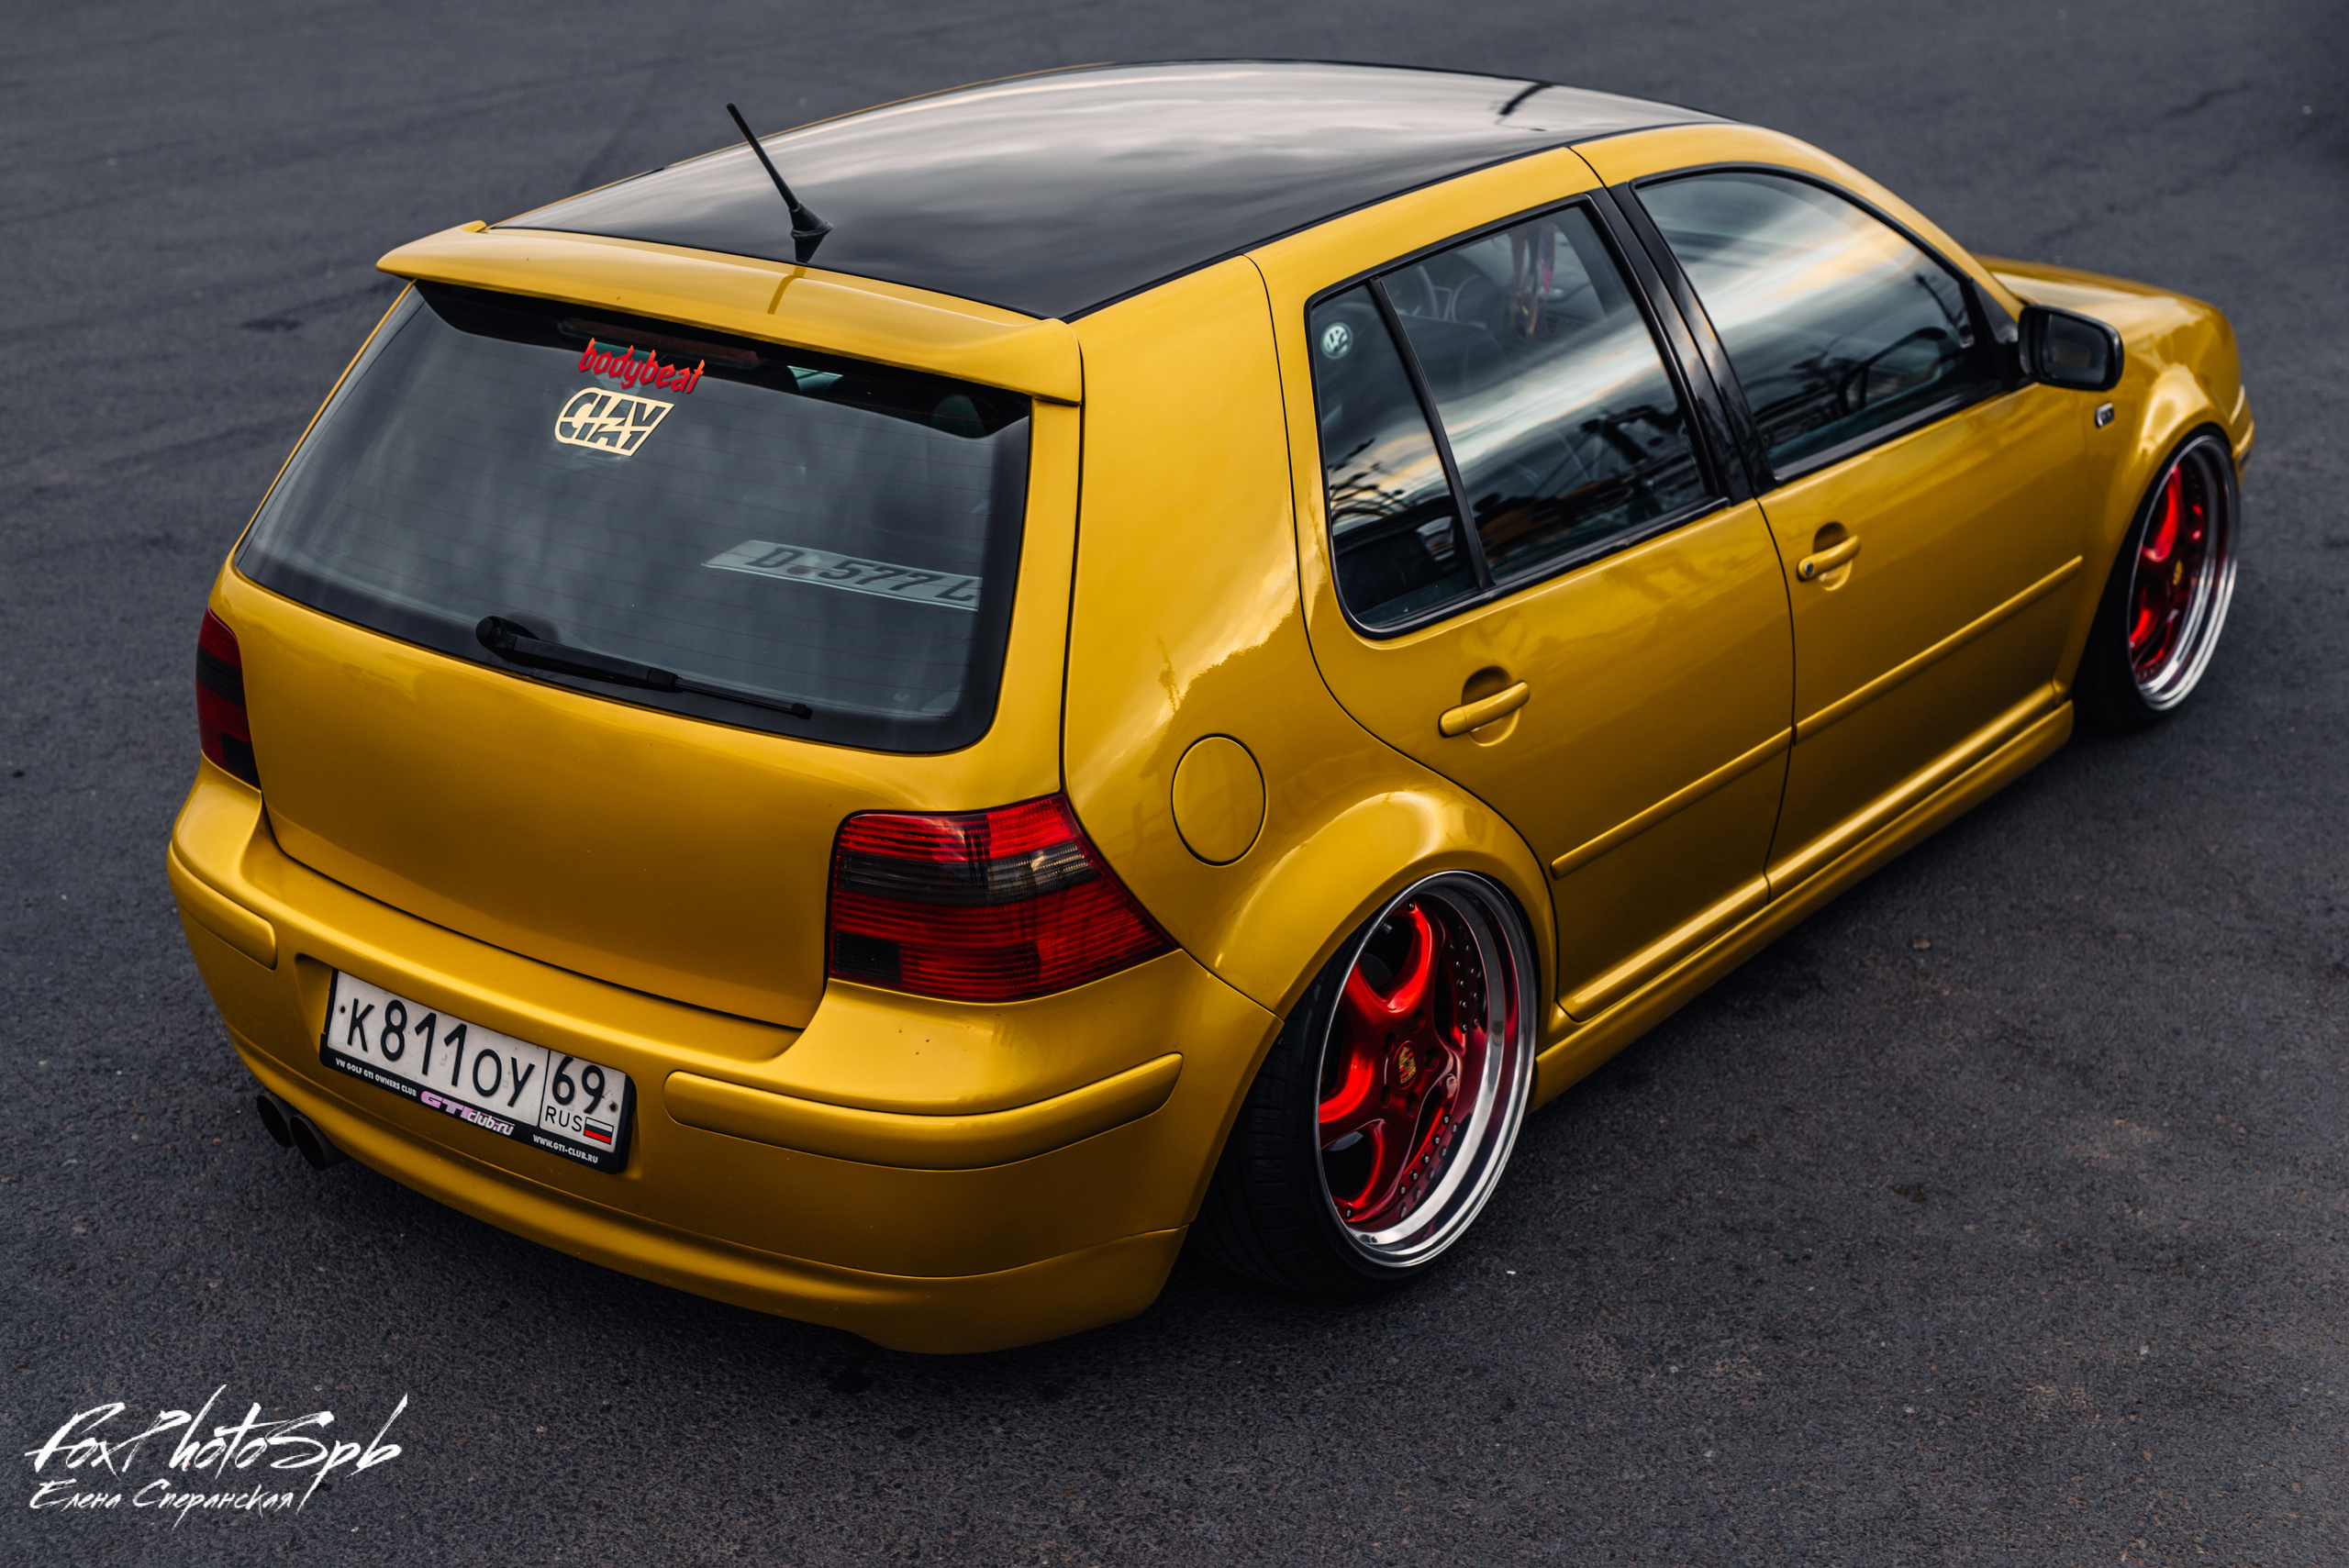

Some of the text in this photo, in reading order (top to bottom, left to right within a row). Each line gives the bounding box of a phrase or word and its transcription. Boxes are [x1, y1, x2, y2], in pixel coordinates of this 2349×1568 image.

[578, 338, 706, 394] bodybeat
[335, 1057, 417, 1096] VW GOLF GTI OWNERS CLUB
[552, 1056, 606, 1114] 69
[545, 1105, 583, 1132] RUS
[532, 1134, 599, 1164] WWW.GTI-CLUB.RU
